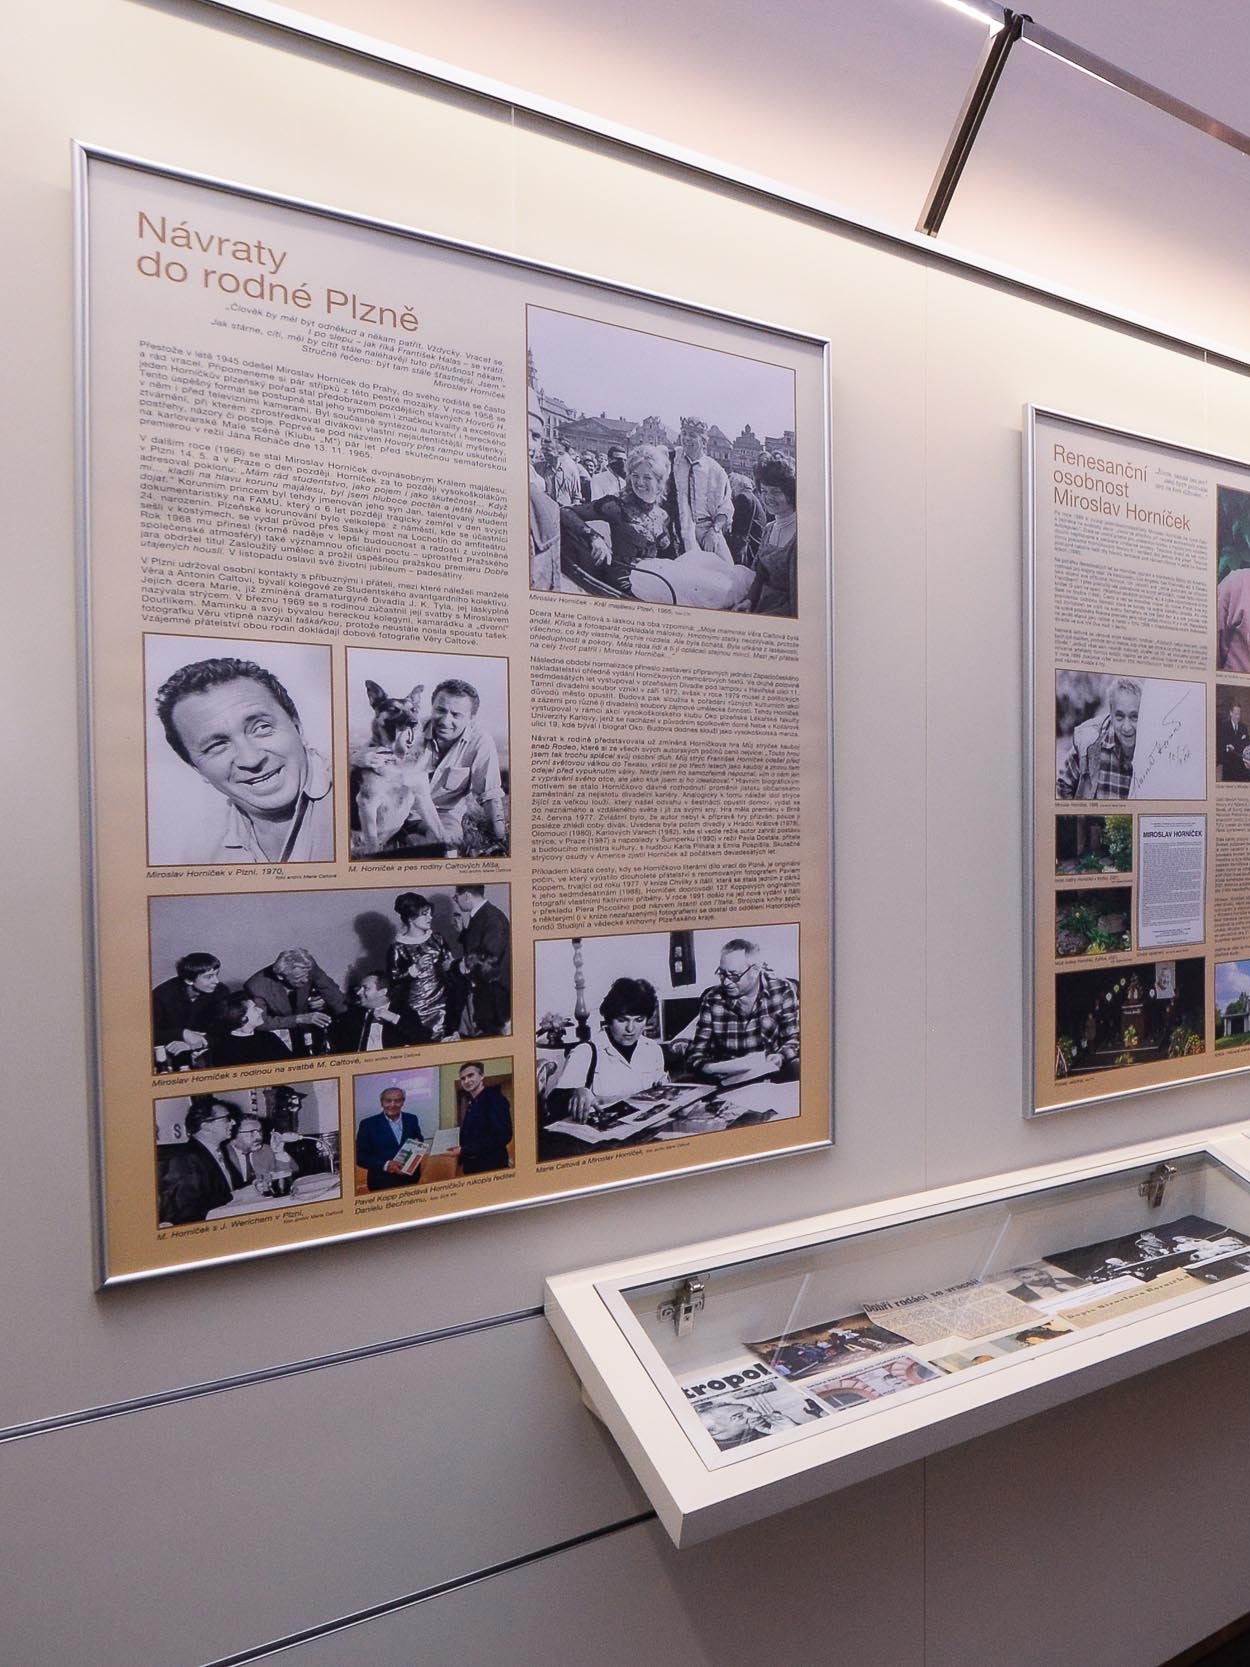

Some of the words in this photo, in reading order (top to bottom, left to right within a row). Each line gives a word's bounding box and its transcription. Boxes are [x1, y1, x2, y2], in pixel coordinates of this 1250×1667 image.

[137, 211, 287, 275] Návraty
[137, 252, 187, 283] do
[204, 267, 312, 309] rodné
[326, 288, 420, 332] Plzně
[1054, 444, 1147, 482] Renesanční
[1053, 472, 1129, 498] osobnost
[1054, 488, 1121, 517] Miroslav
[1126, 502, 1191, 531] Horníček
[1173, 830, 1203, 838] HORNÍČEK
[863, 1301, 893, 1313] Dobří
[895, 1293, 928, 1307] rodáci
